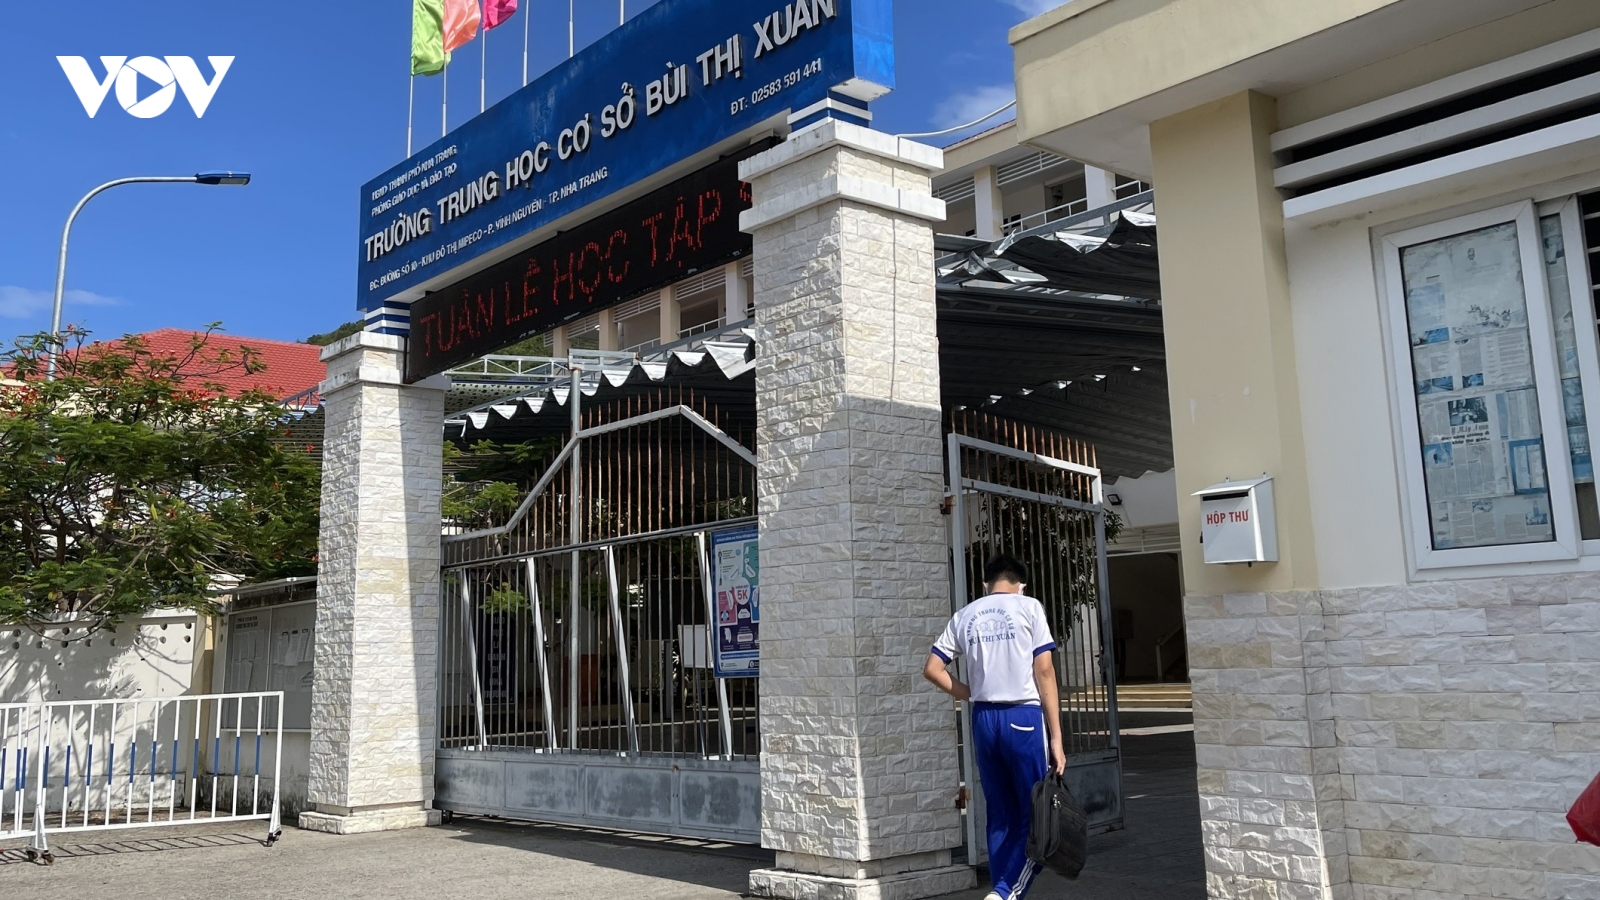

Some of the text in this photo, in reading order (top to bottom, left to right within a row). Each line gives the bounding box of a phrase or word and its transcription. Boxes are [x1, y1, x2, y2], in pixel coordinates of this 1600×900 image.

[731, 57, 822, 115] ĐT: 02583 591 441
[365, 207, 432, 262] TRƯỜNG
[437, 170, 500, 224] TRUNG
[505, 141, 549, 190] HỌC
[557, 113, 593, 160] CƠ
[600, 81, 636, 138] SỞ
[646, 61, 688, 116] BÙI
[696, 33, 743, 86] THỊ
[408, 161, 422, 180] PHỐ
[421, 158, 435, 173] NHA
[434, 144, 458, 165] TRANG
[371, 200, 392, 217] PHÒNG
[407, 183, 420, 198] DỤC
[420, 177, 429, 190] VÀ
[429, 170, 443, 186] ĐÀO
[443, 162, 457, 178] TẠO
[401, 260, 410, 275] SỐ
[410, 262, 418, 272] 10
[435, 245, 446, 260] ĐÔ
[446, 241, 458, 254] THỊ
[458, 228, 483, 250] MIPECO
[487, 223, 495, 235] P.
[548, 191, 560, 204] TP.
[560, 181, 578, 199] NHA
[579, 166, 608, 189] TRANG
[552, 229, 630, 306] HỌC
[641, 188, 723, 268] TẬP
[1206, 508, 1249, 527] HỘP THƯ
[737, 588, 749, 601] 5K
